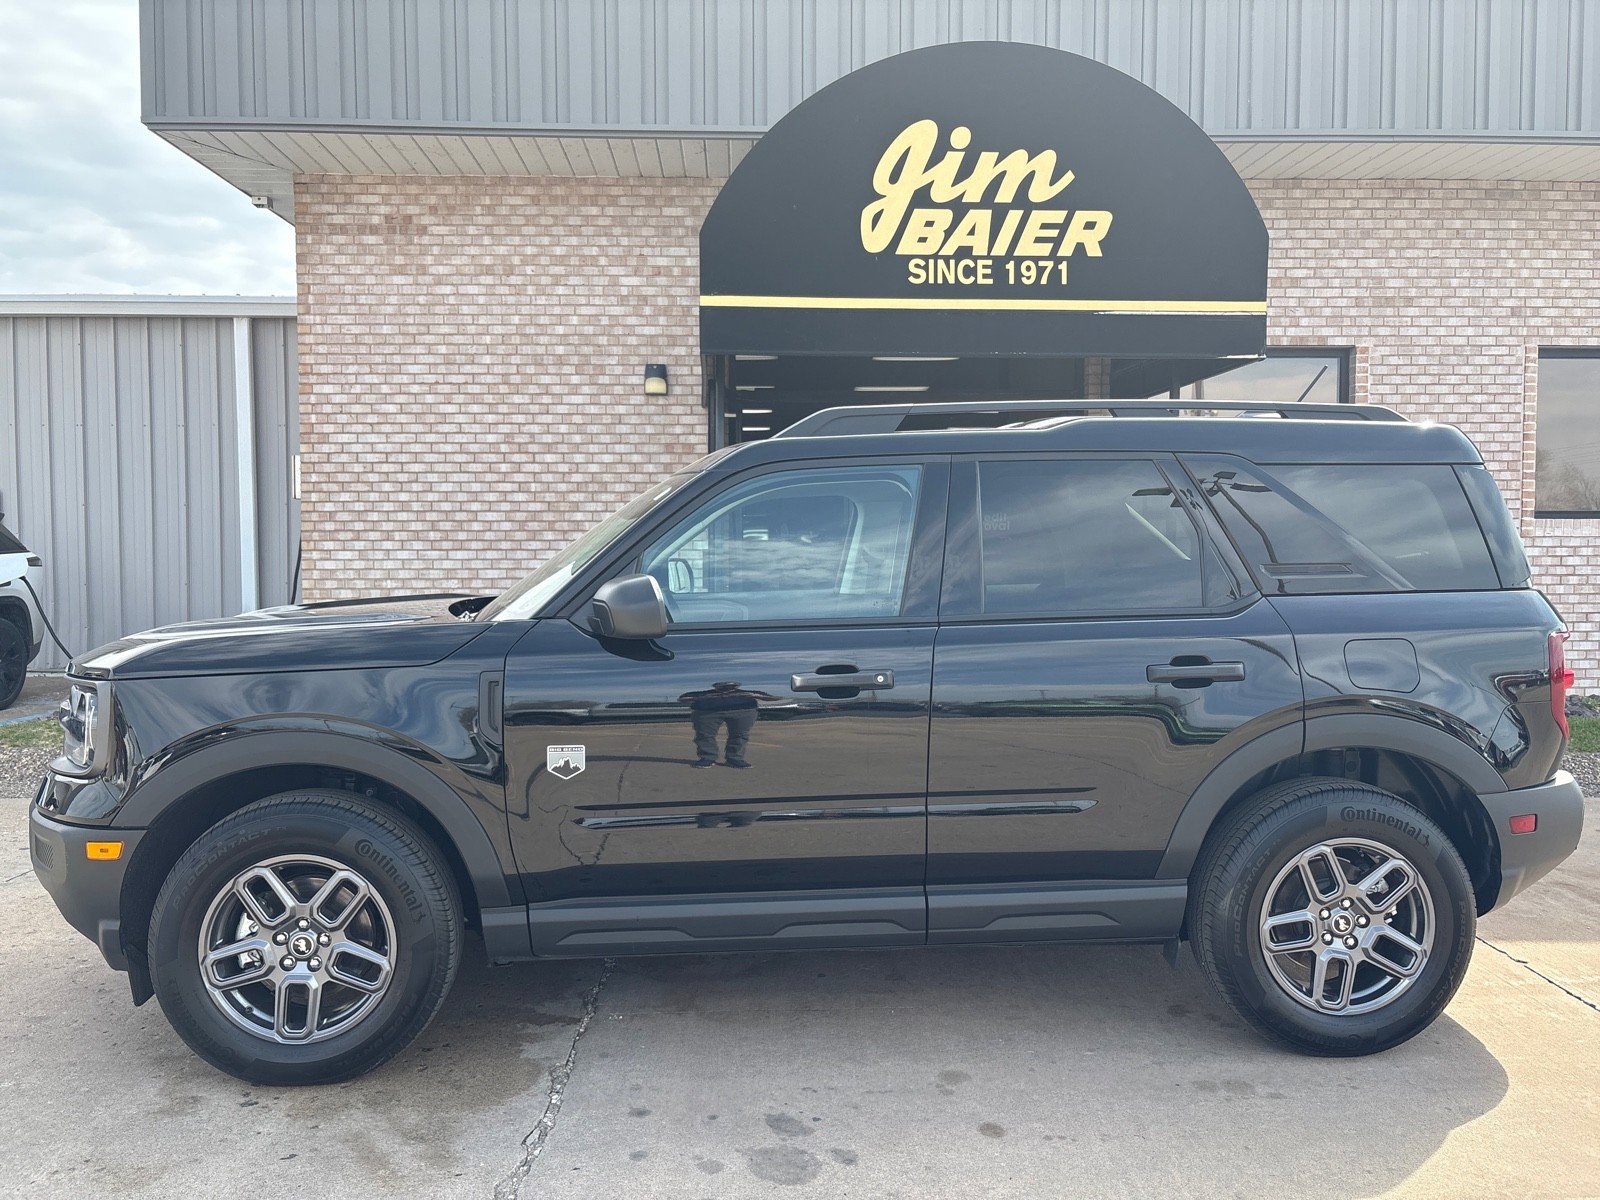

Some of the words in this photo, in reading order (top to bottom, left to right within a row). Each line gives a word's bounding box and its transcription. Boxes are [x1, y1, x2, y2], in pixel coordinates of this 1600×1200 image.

[860, 119, 1075, 253] Jim
[895, 208, 1113, 256] BAIER
[907, 258, 993, 284] SINCE
[1005, 260, 1068, 285] 1971
[1340, 806, 1422, 841] Continental
[354, 839, 423, 912] Continental
